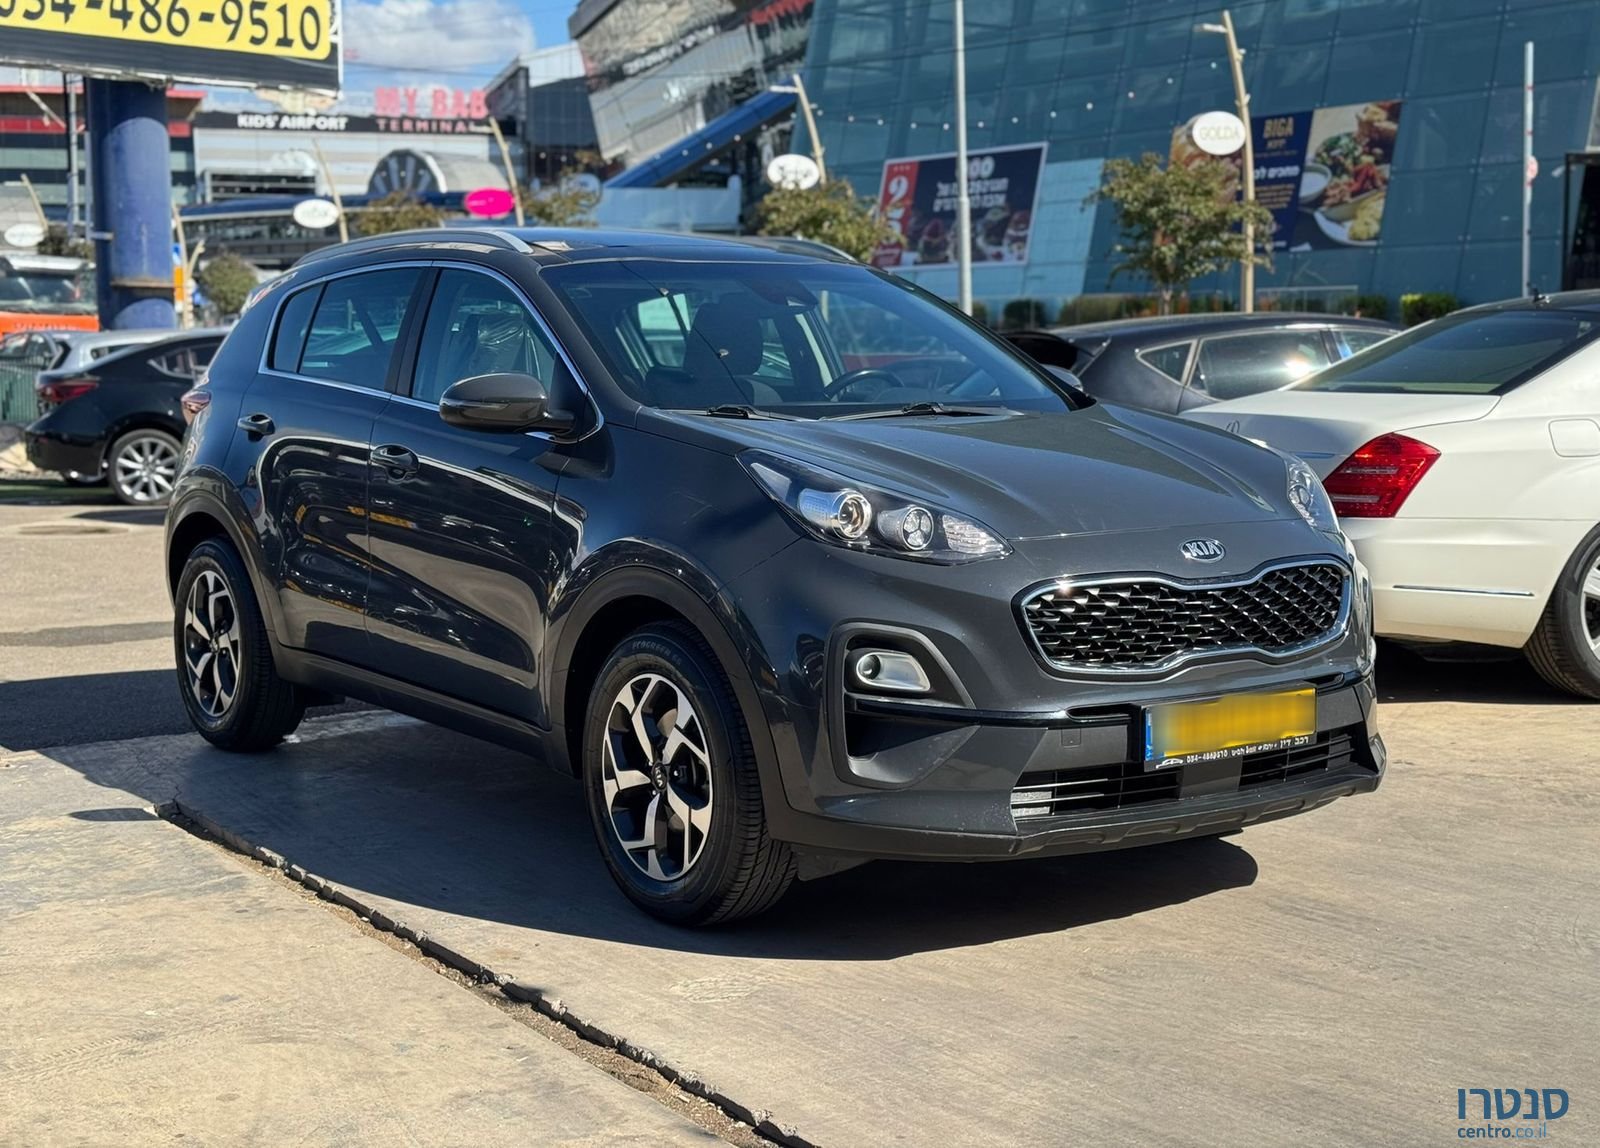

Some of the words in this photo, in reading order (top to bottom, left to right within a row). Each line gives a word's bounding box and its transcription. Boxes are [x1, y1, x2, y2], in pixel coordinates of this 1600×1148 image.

[375, 87, 417, 117] MY
[279, 115, 348, 131] AIRPORT
[1185, 541, 1221, 556] KIA
